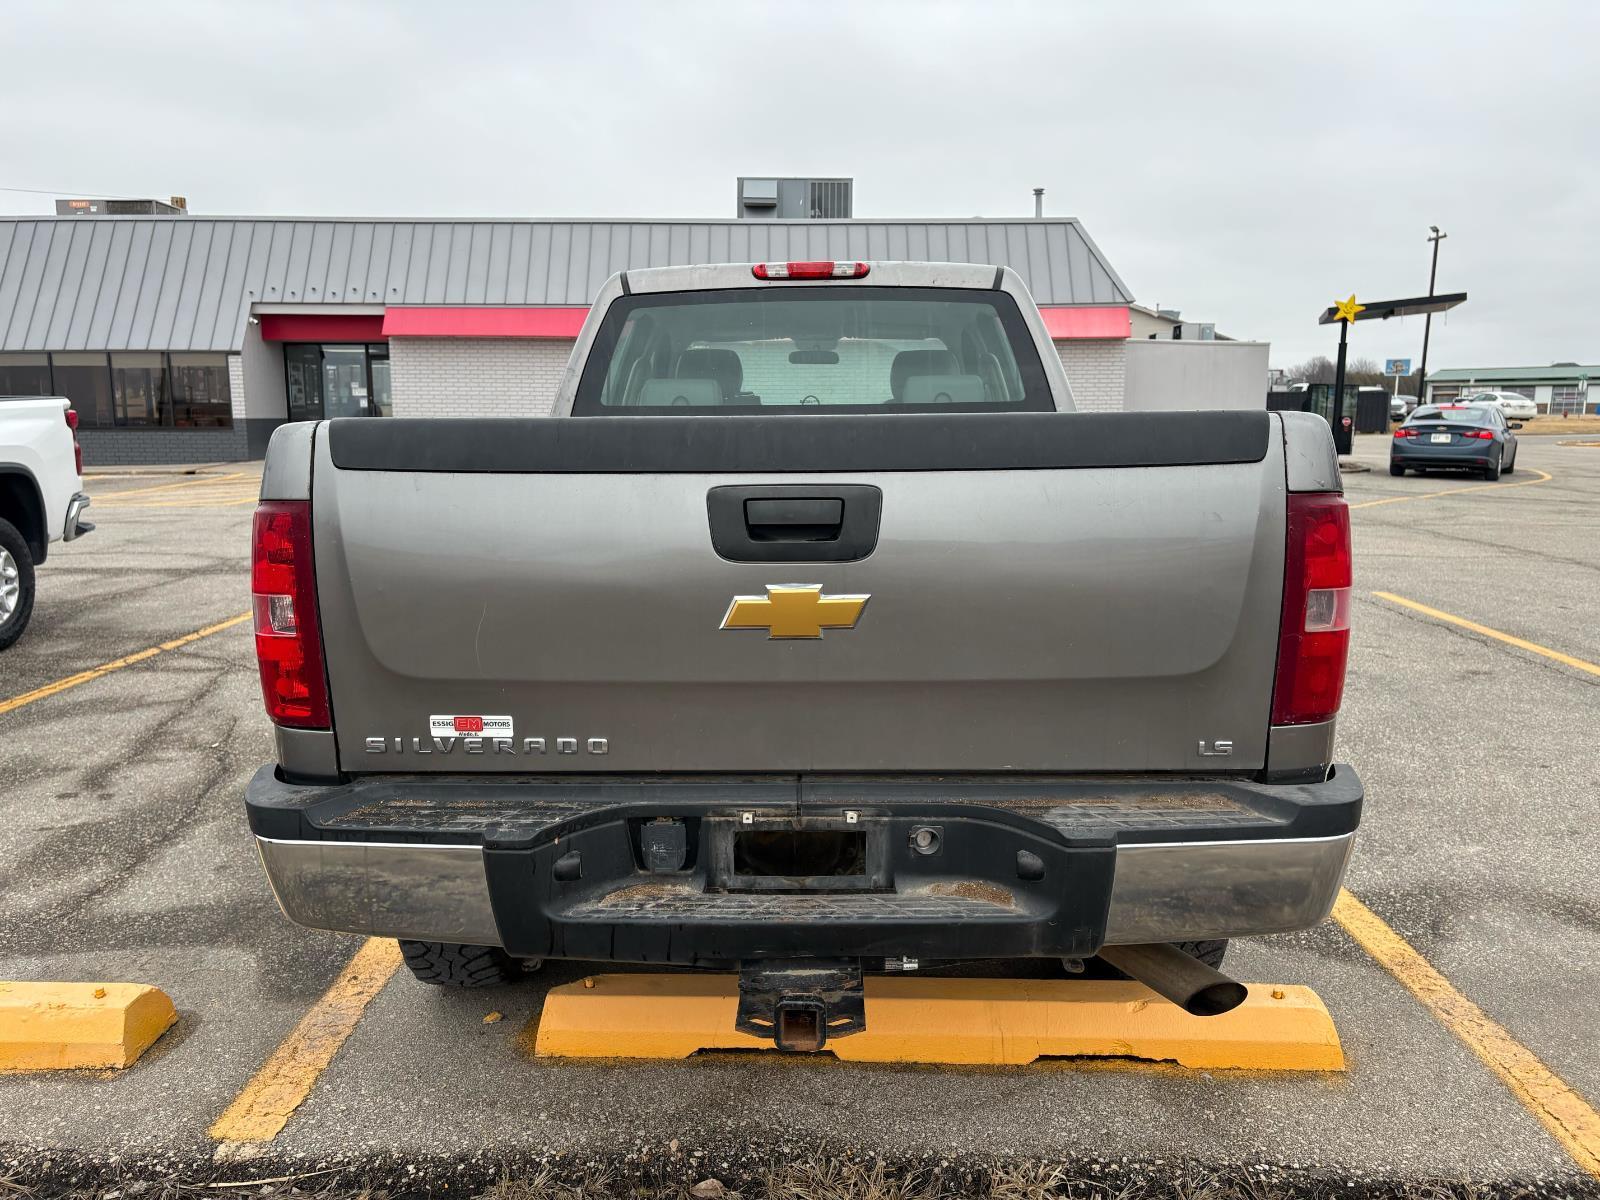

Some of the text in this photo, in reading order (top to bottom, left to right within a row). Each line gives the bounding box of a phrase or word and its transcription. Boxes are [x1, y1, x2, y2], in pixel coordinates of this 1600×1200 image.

[456, 719, 481, 729] EM
[365, 737, 609, 754] SILVERADO
[1199, 741, 1233, 756] LS
